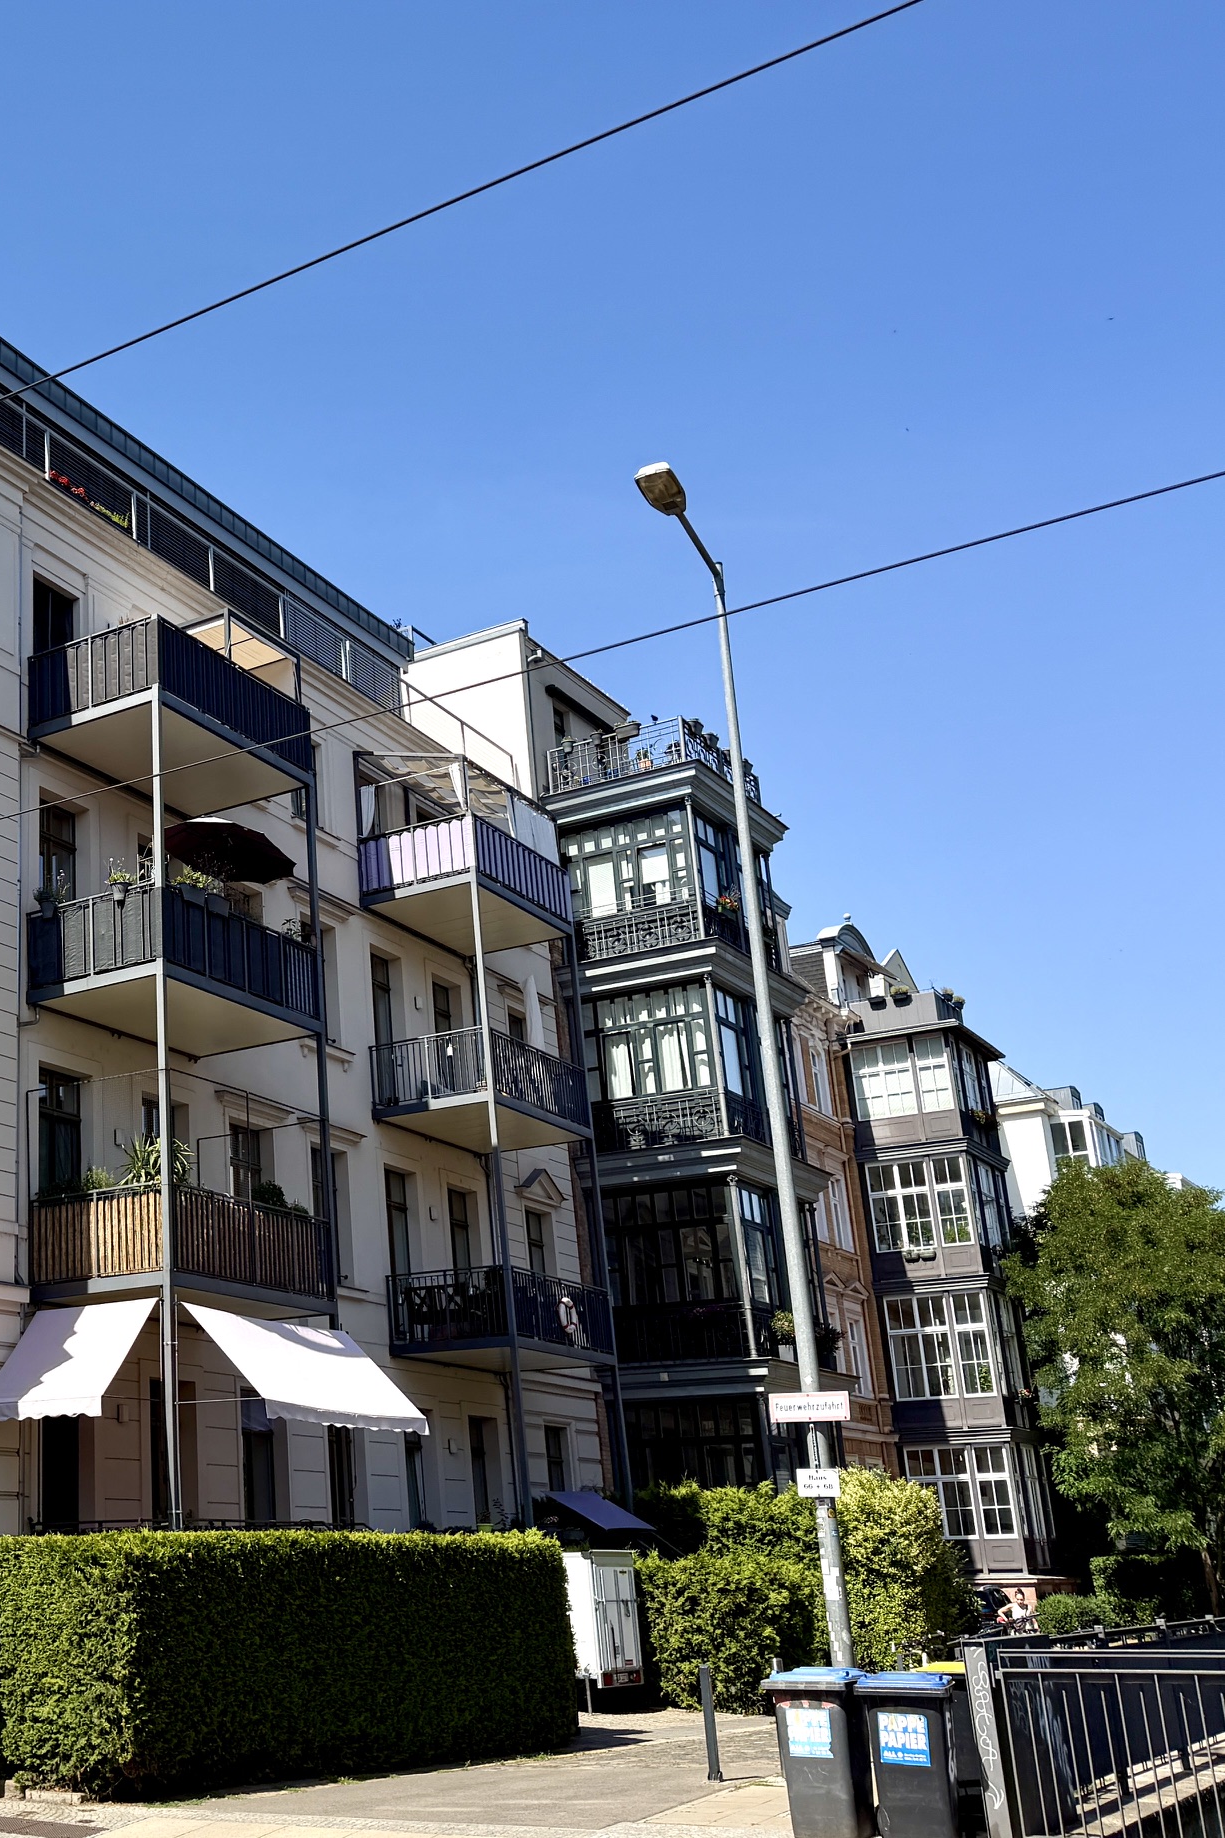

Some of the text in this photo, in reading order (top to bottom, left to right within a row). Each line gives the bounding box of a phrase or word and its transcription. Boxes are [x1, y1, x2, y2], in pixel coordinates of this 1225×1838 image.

[774, 1401, 844, 1412] Feuerwehrzufahrt
[878, 1713, 926, 1733] PAPPE
[879, 1730, 928, 1750] PAPIER
